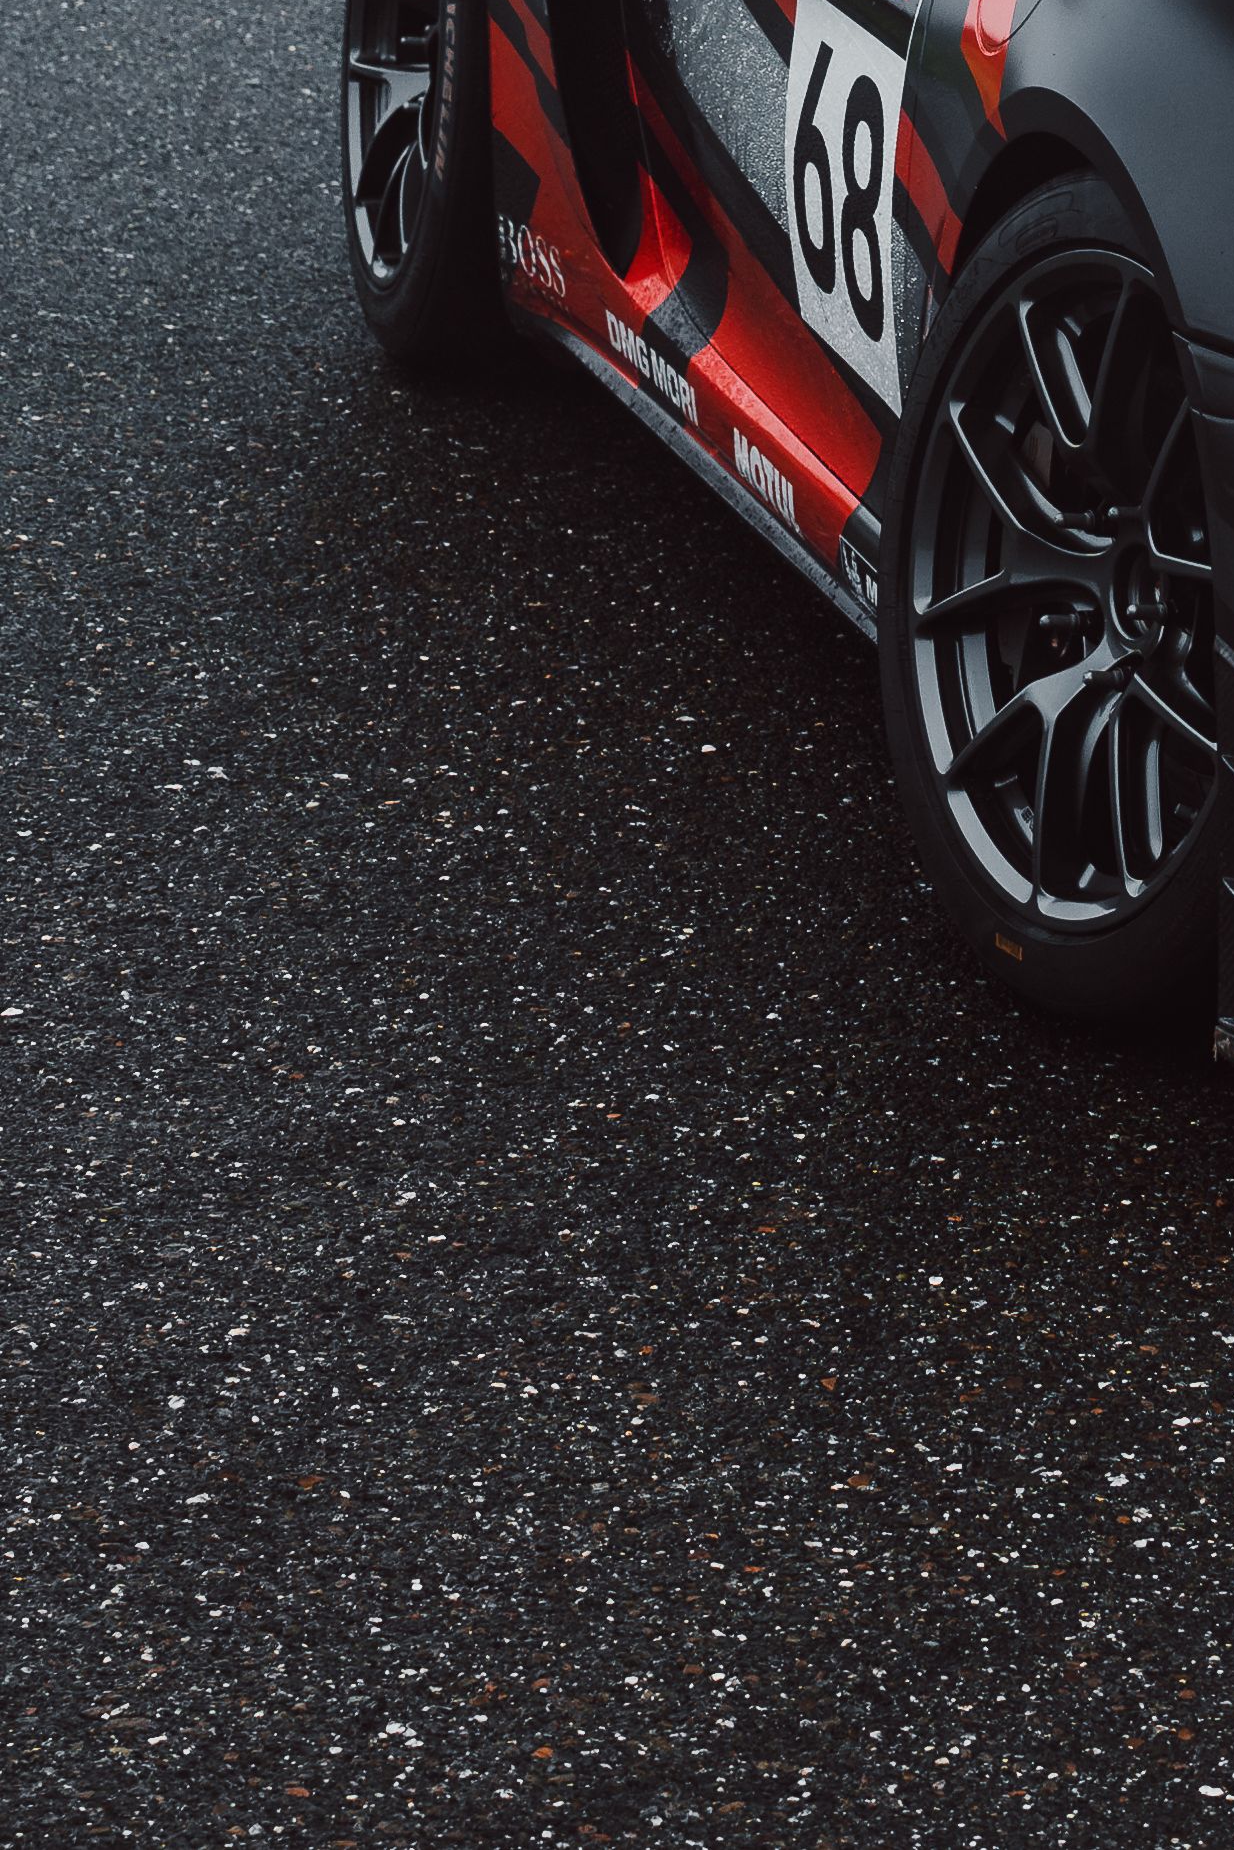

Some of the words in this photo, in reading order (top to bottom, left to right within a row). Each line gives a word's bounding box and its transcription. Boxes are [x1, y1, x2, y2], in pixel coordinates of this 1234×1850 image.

[793, 40, 885, 343] 68
[498, 214, 566, 298] BOSS
[605, 309, 651, 379] DMG
[650, 348, 699, 427] MORI
[733, 426, 800, 534] MOTUL
